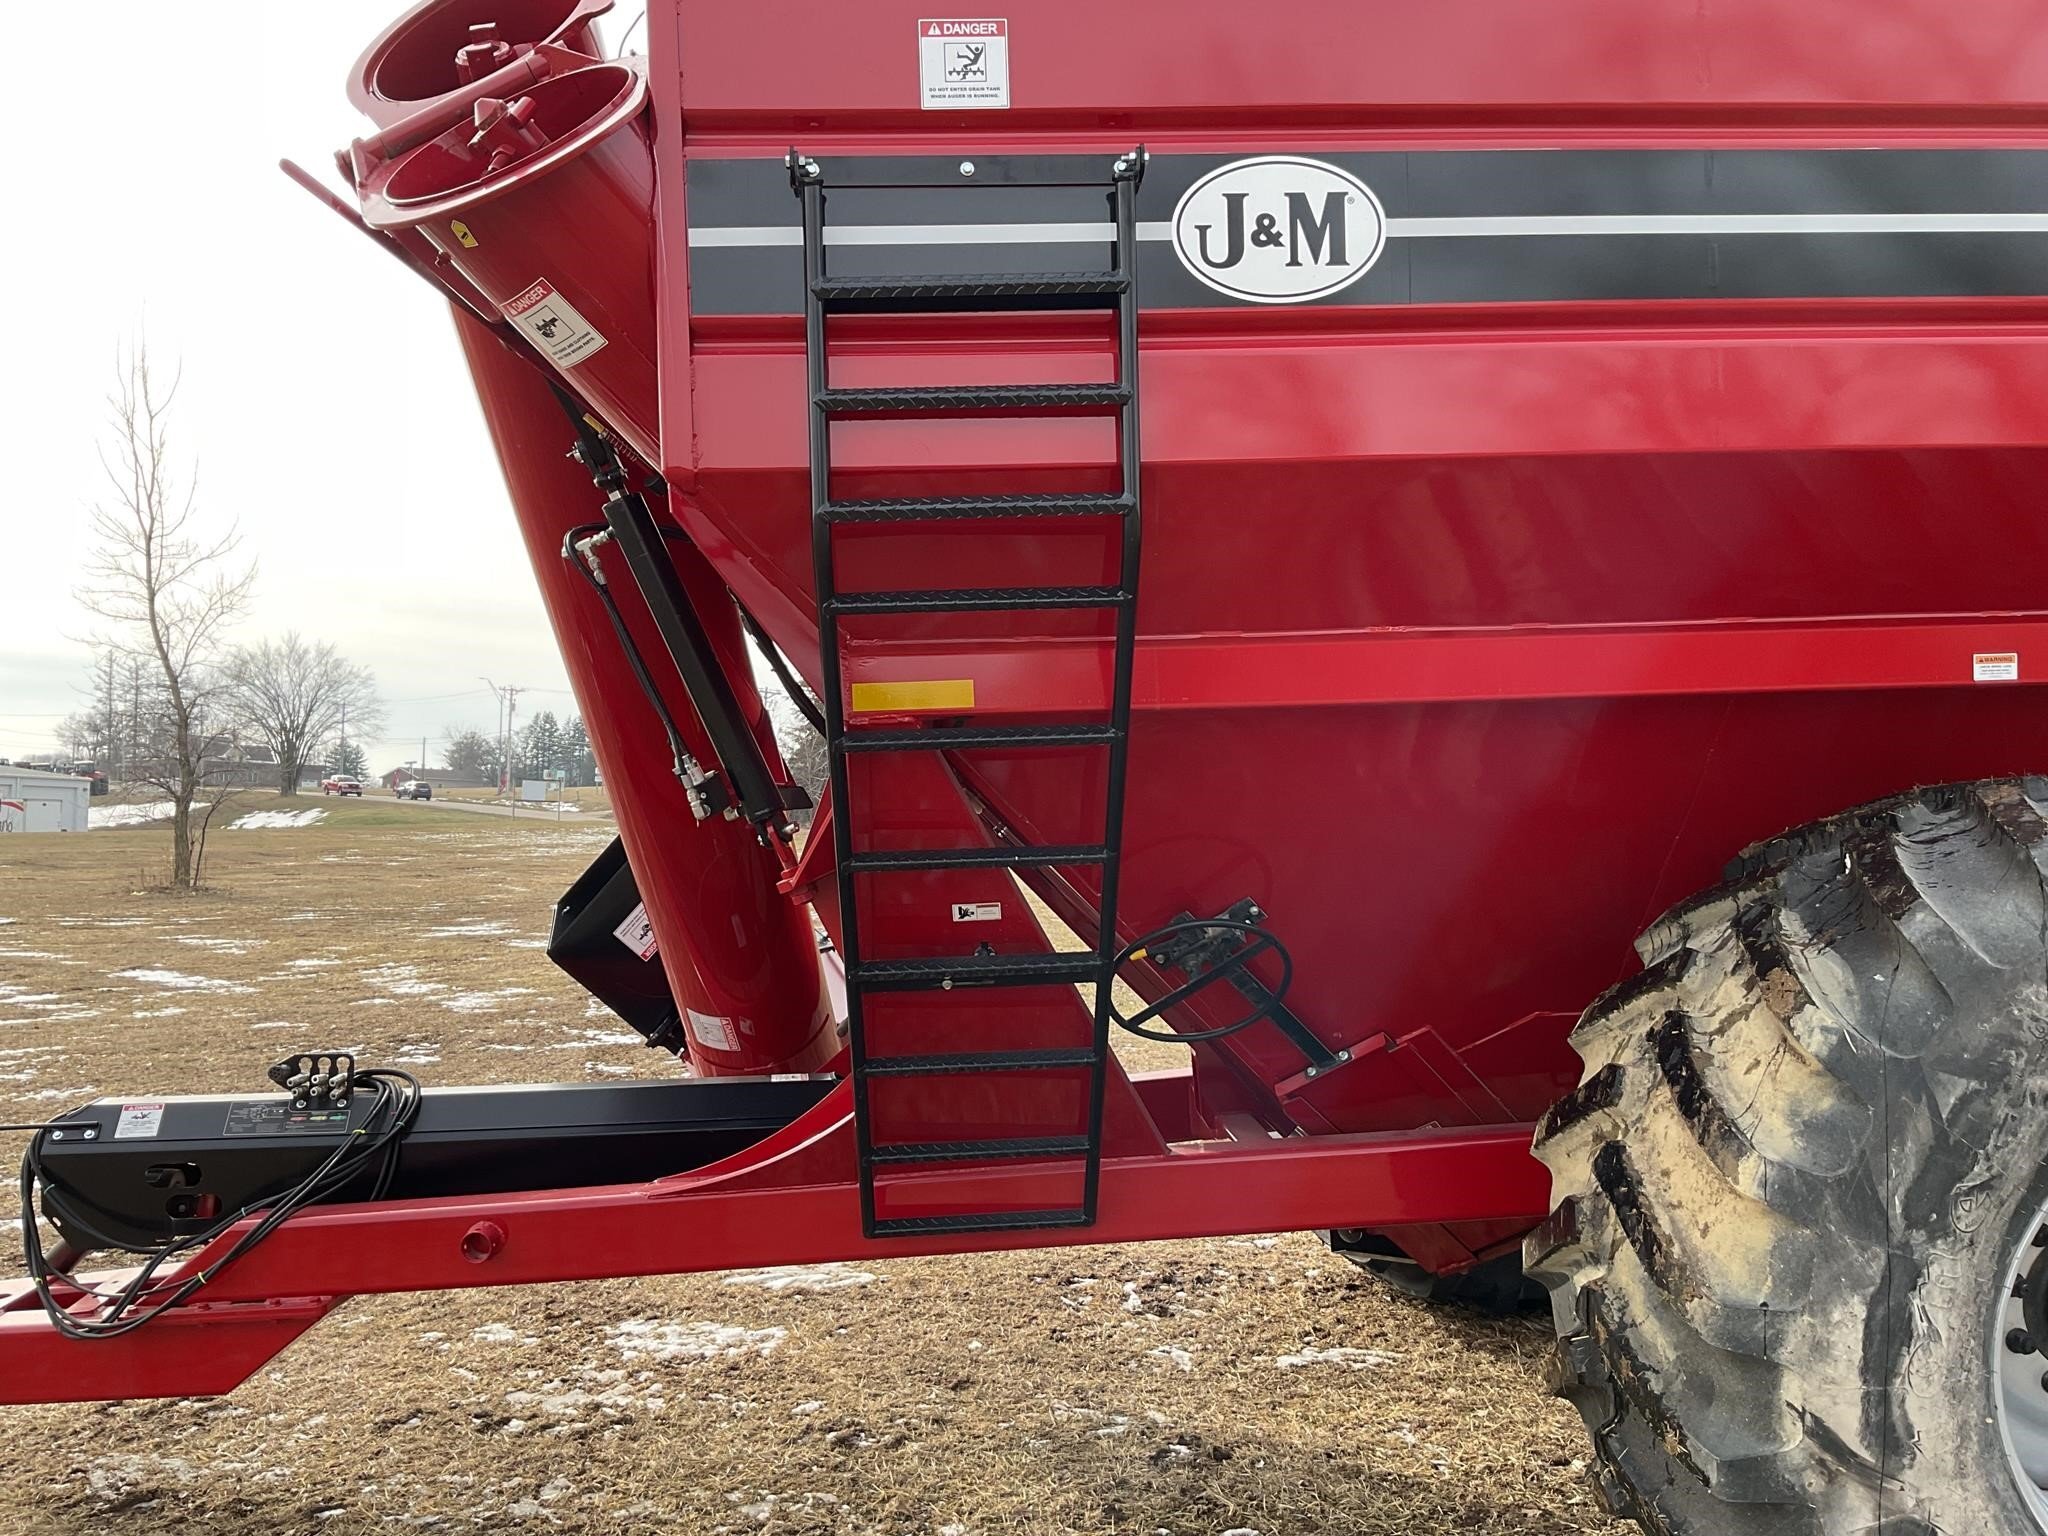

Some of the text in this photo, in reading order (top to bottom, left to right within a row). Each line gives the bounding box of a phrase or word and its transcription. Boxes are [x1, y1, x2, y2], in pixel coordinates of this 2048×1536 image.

[943, 23, 998, 35] DANGER
[1194, 191, 1351, 270] J&M
[511, 285, 548, 312] DANGER
